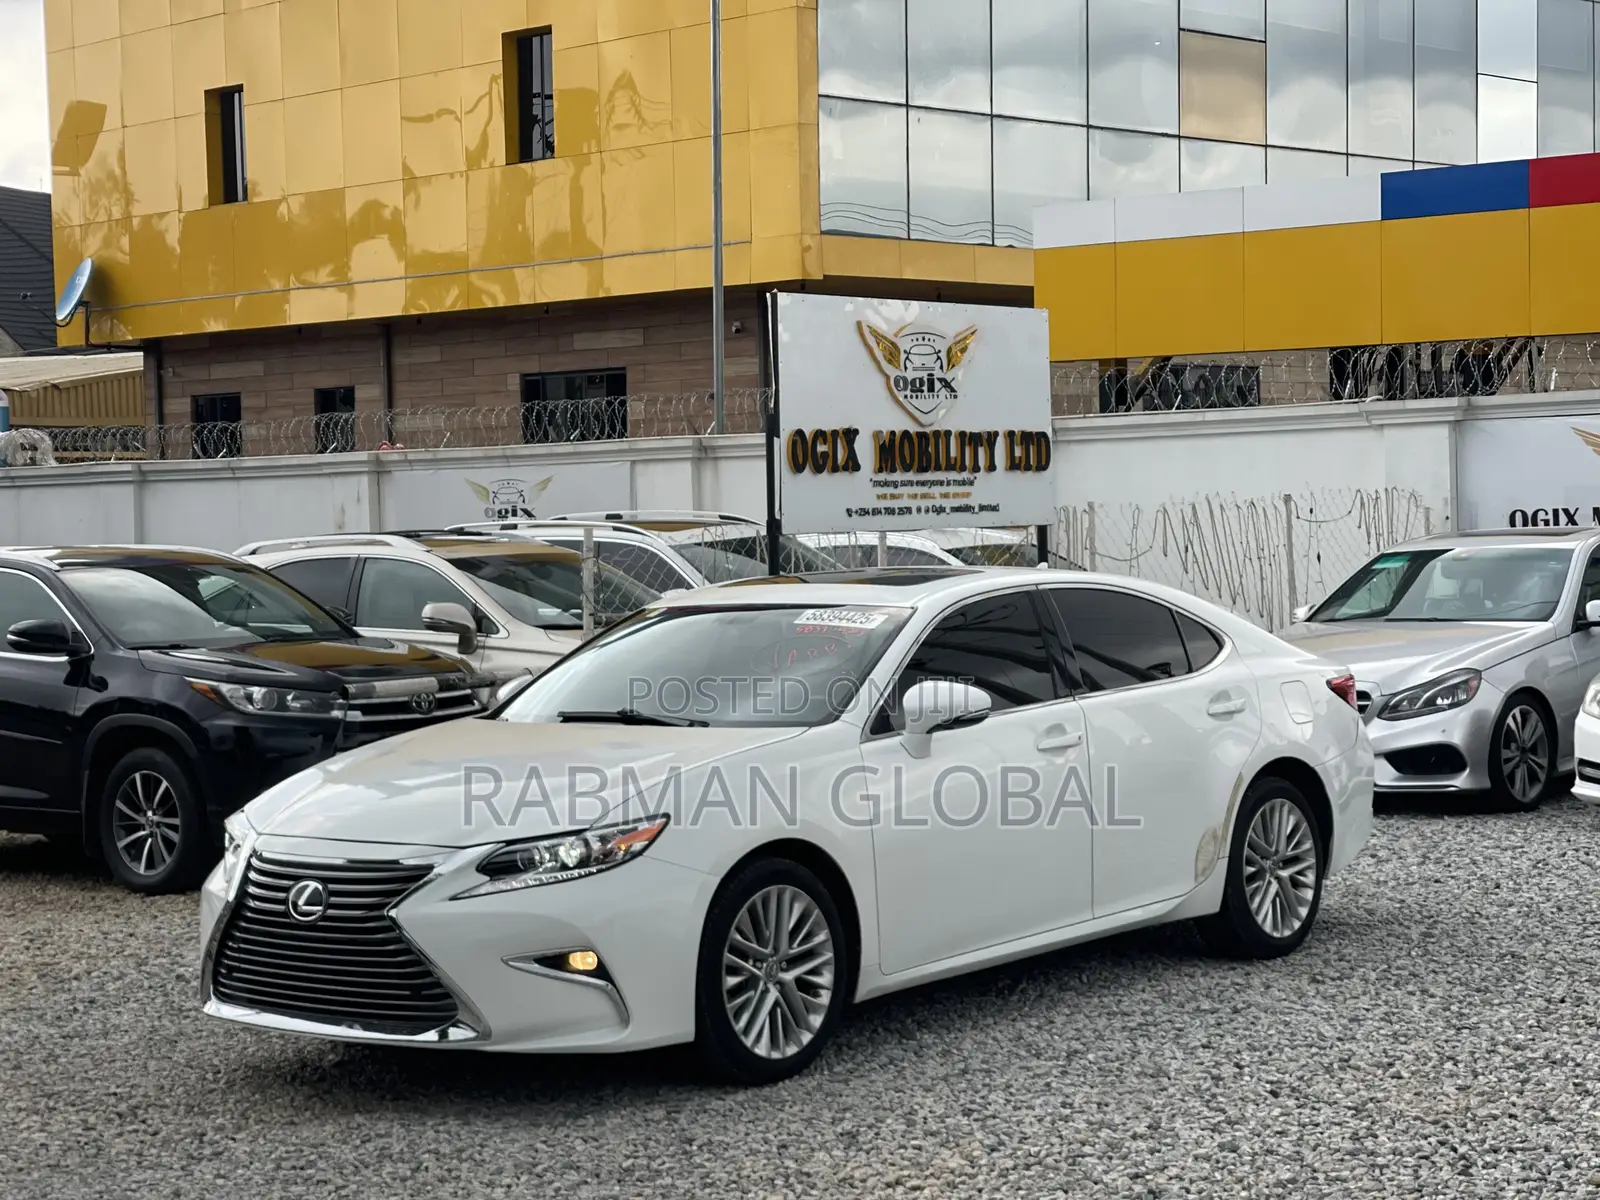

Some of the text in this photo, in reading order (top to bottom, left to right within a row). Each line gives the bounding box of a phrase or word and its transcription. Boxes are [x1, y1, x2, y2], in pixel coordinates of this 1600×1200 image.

[786, 428, 1051, 474] OGIX MOBILITY LTD
[900, 478, 914, 488] sure
[916, 477, 944, 489] everyone
[945, 476, 952, 487] is
[854, 507, 870, 516] +234
[1509, 507, 1579, 528] OGIX
